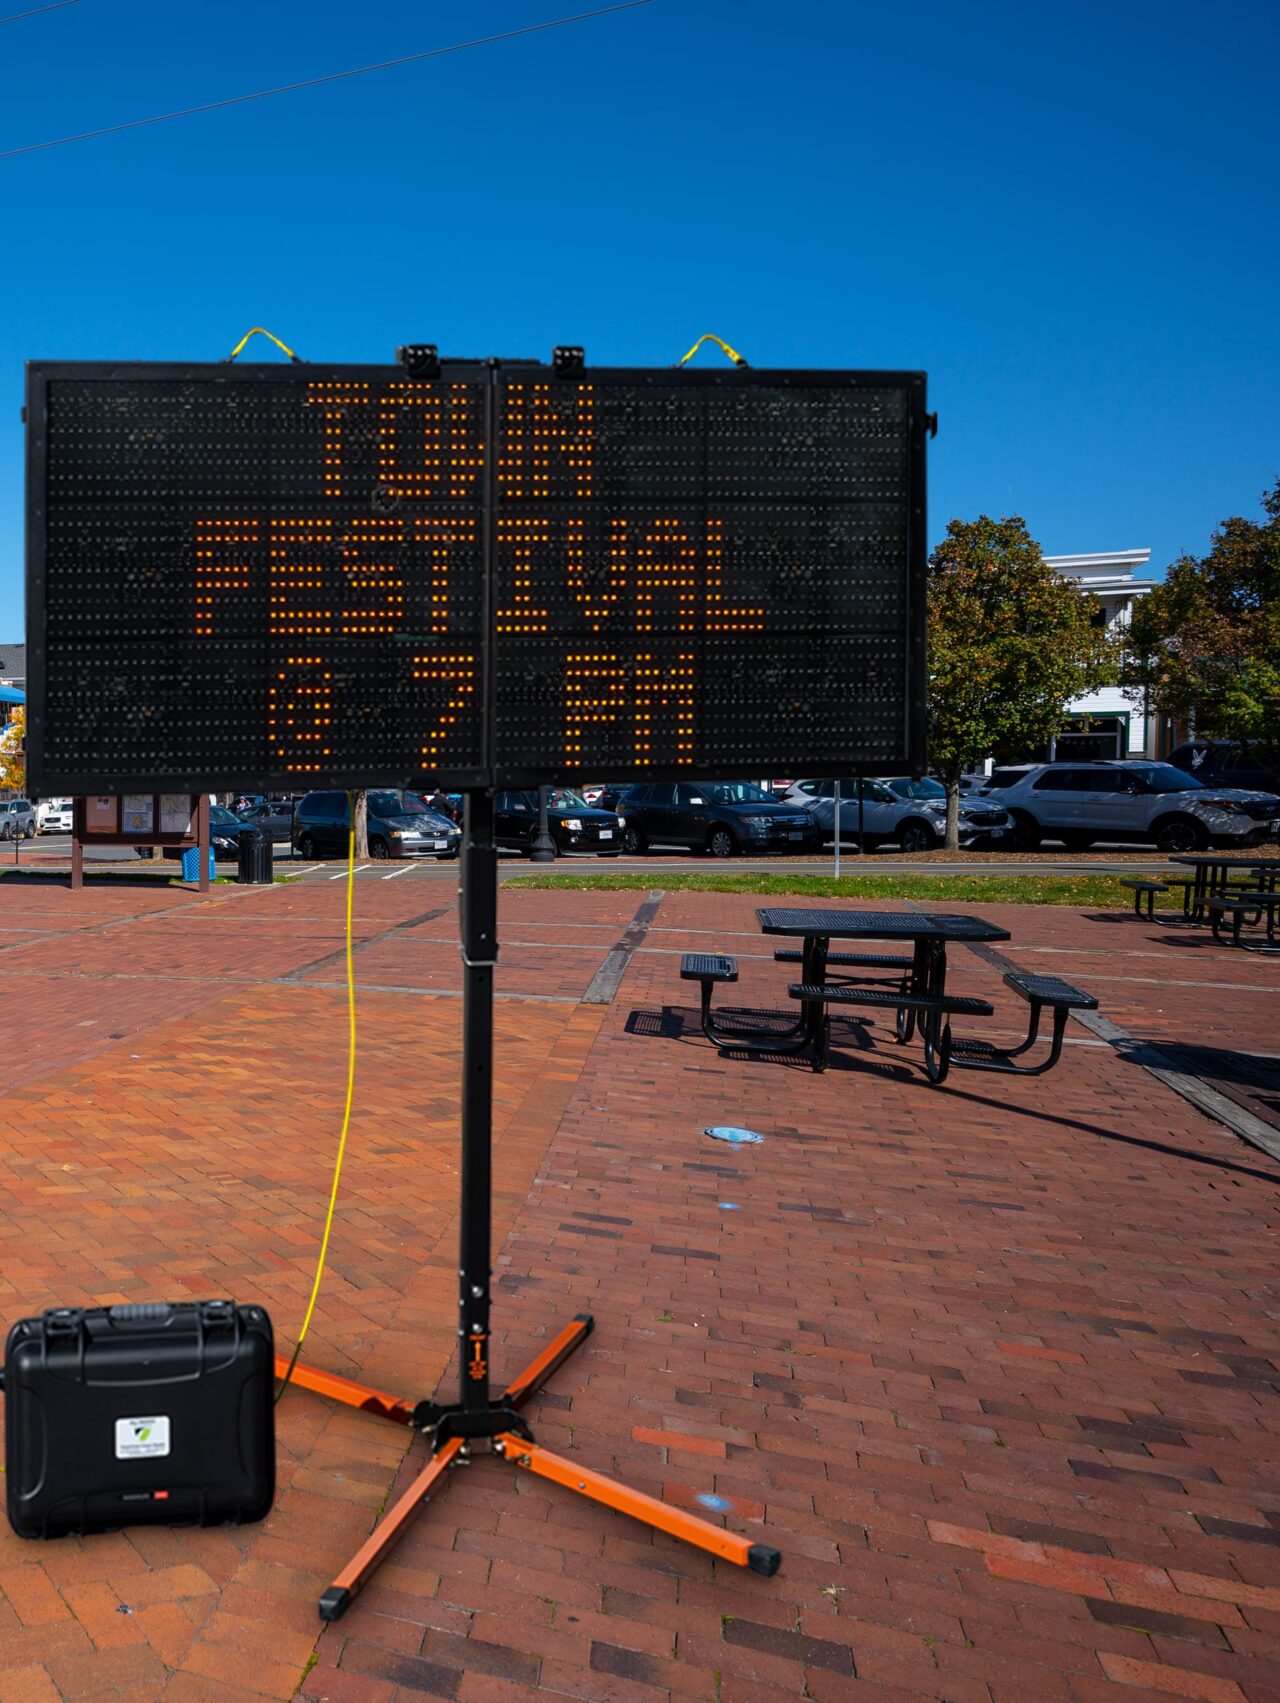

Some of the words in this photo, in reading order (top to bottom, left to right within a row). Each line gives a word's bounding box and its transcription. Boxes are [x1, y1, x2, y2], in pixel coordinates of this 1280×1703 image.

[308, 382, 594, 496] TOWN
[194, 518, 766, 636] FESTIVAL
[412, 655, 474, 769] 7
[565, 653, 694, 767] PM
